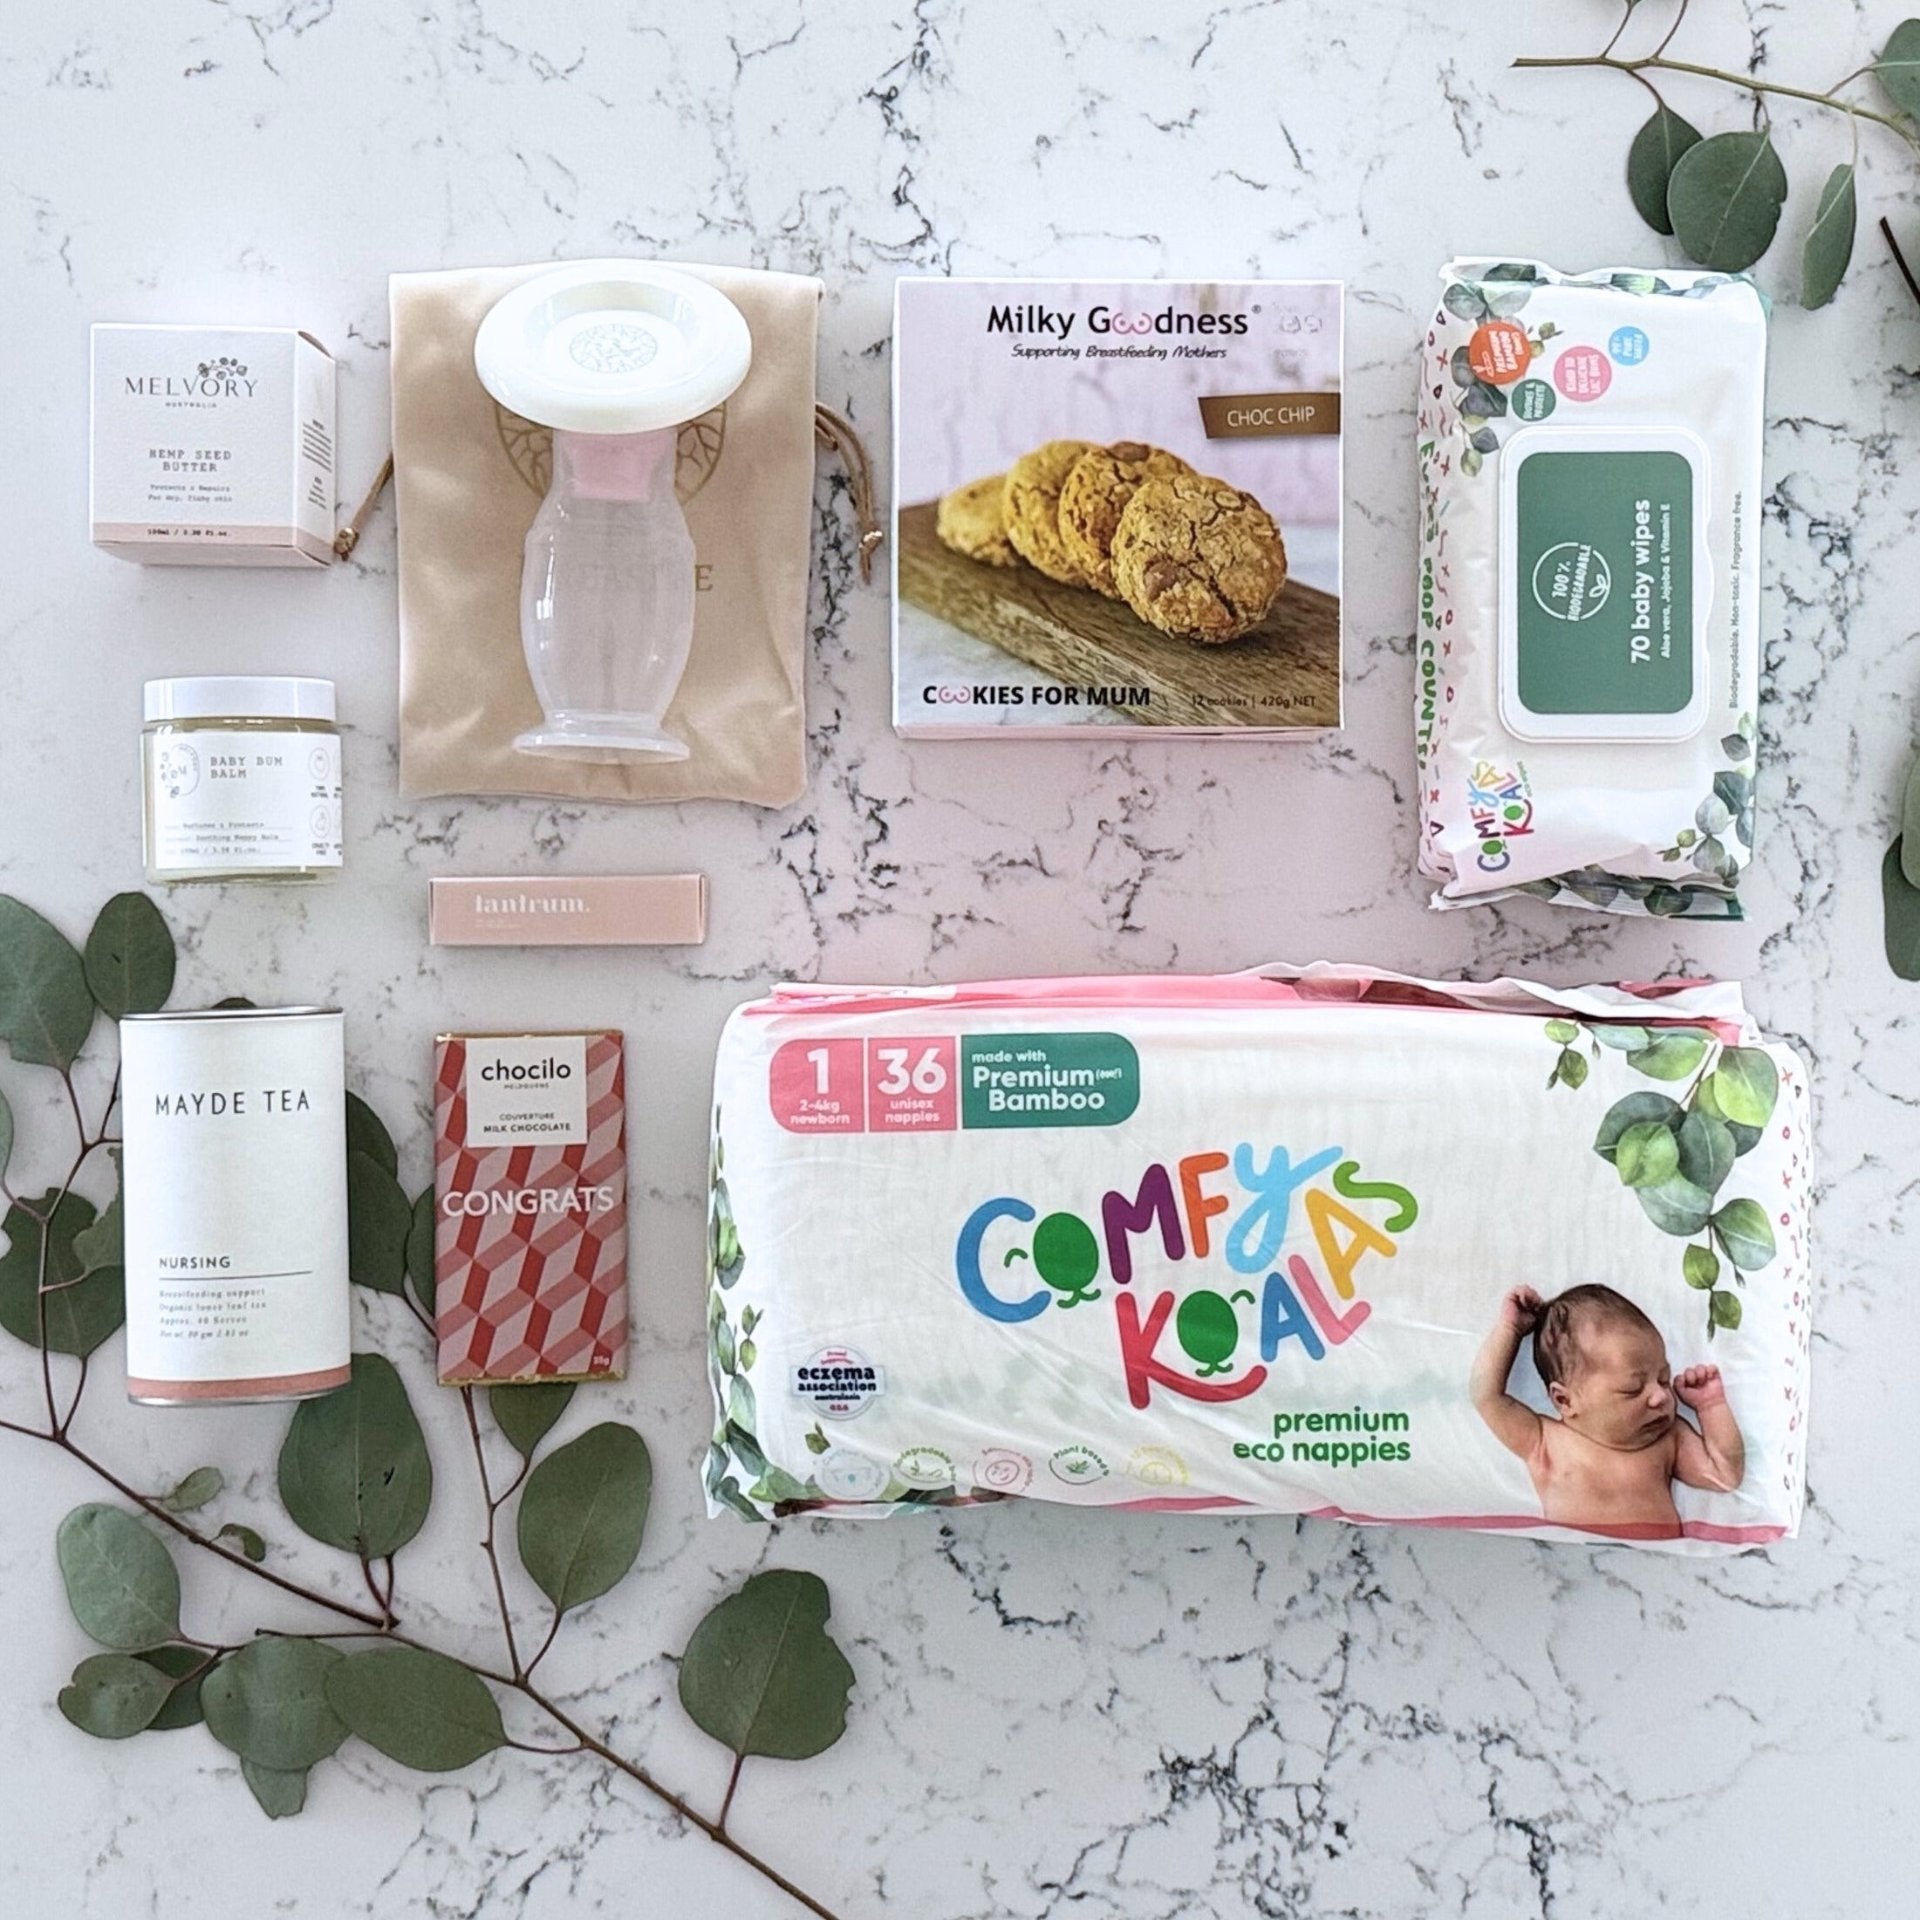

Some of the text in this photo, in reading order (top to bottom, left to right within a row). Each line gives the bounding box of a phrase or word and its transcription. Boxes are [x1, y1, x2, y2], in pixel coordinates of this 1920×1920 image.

[987, 305, 1075, 340] Milky
[1011, 343, 1227, 360] Supporting Breastfeeding Mothers
[124, 376, 259, 397] MELVORY
[1227, 407, 1316, 427] CHOC CHIP
[149, 449, 232, 461] HEMP SEED
[162, 462, 218, 472] BUTTER
[1660, 512, 1671, 554] Vitamin
[1731, 516, 1743, 571] Fragrance
[1661, 555, 1671, 564] &
[1552, 560, 1571, 598] 100%
[1567, 544, 1592, 622] BIODEGRADABLE
[1630, 499, 1654, 664] 70 baby wipes
[1660, 565, 1673, 603] Jojoba
[1660, 634, 1671, 658] Aloe
[1729, 629, 1741, 709] Biodegradable.
[923, 685, 1150, 706] COOKIES FOR MUM
[1192, 694, 1316, 709] 12 cookies 420g NET
[210, 756, 246, 767] BABY
[256, 756, 283, 766] BUM
[210, 769, 247, 779] BALM
[1471, 761, 1534, 836] KOALAS
[972, 1049, 1046, 1063] made with
[481, 1057, 571, 1082] chocilo
[807, 1048, 829, 1094] 1
[877, 1047, 947, 1095] 36
[973, 1064, 1095, 1088] Premium
[156, 1089, 310, 1116] MAYDE TEA
[799, 1100, 840, 1112] 2-4kg
[890, 1097, 934, 1110] unisex
[988, 1088, 1106, 1112] Bamboo
[499, 1112, 555, 1121] COUVERTURE
[790, 1112, 850, 1125] newborn
[884, 1110, 940, 1124] nappies
[483, 1122, 571, 1134] MILK CHOCOLATE
[441, 1186, 615, 1218] CONGRATS
[159, 1256, 231, 1269] NURSING
[1114, 1160, 1418, 1410] KOALAS
[797, 1367, 876, 1381] eczema
[798, 1380, 877, 1392] association
[1273, 1405, 1410, 1439] premium
[1232, 1435, 1411, 1468] eco nappies
